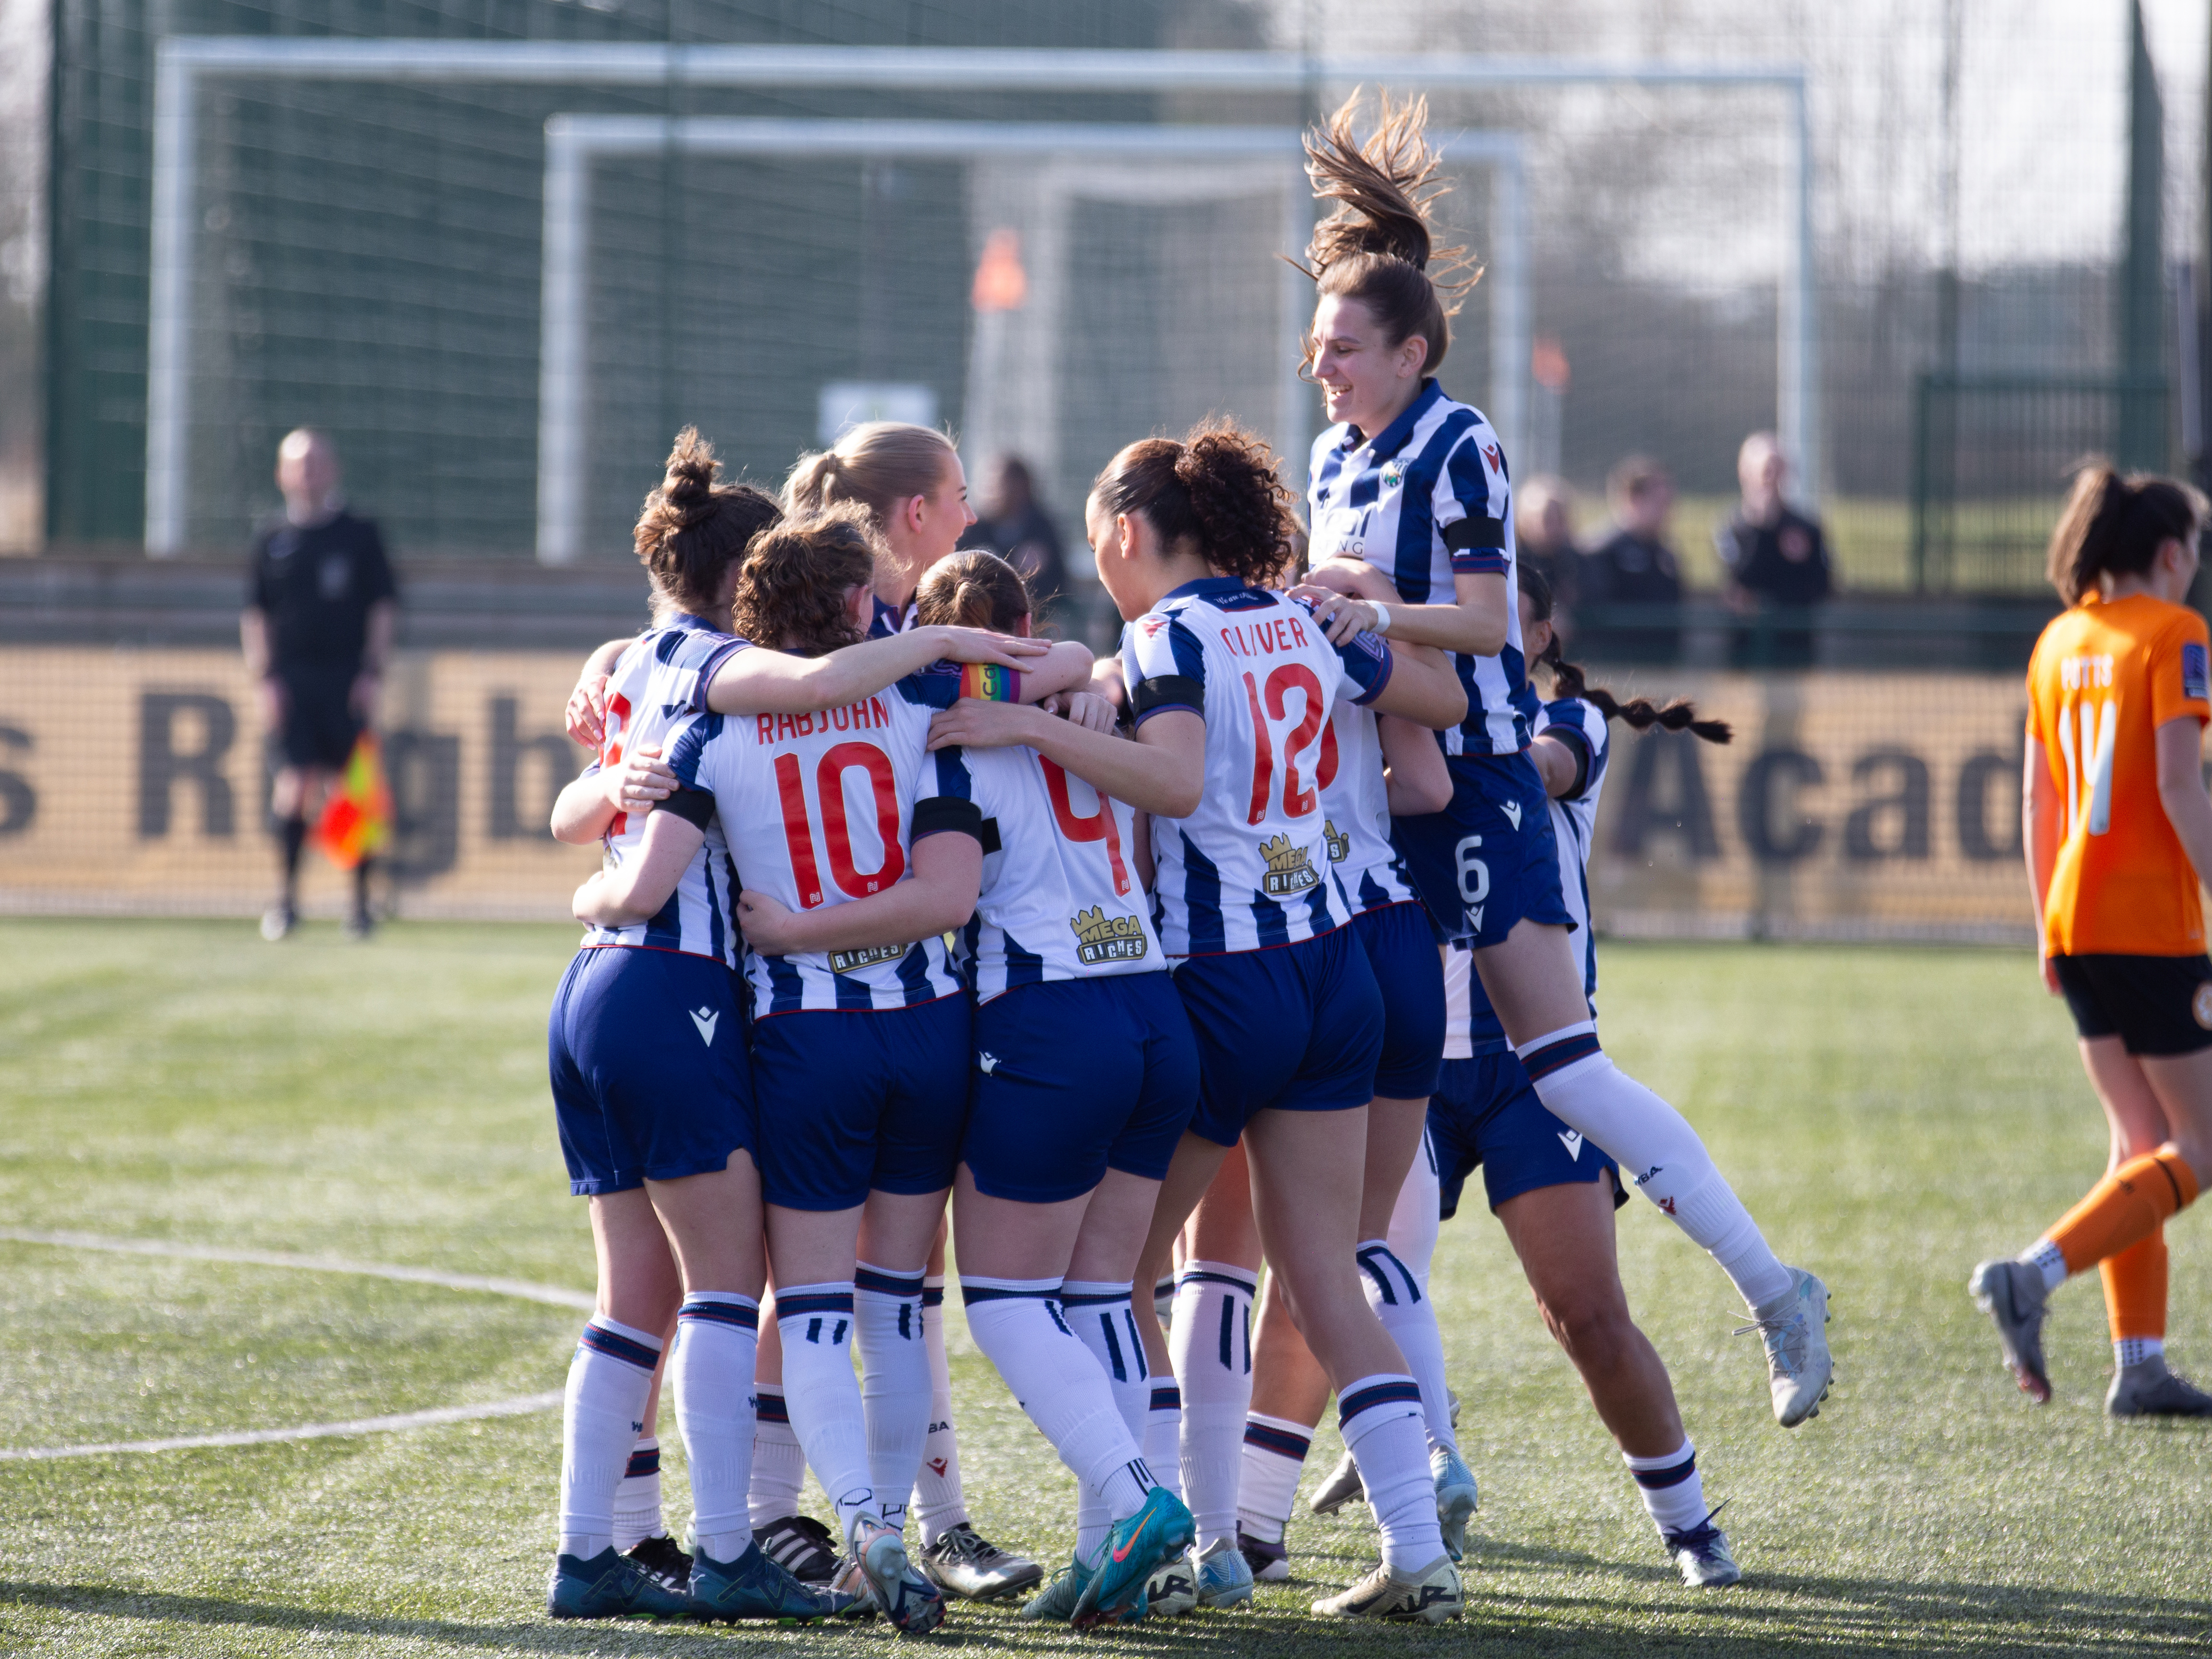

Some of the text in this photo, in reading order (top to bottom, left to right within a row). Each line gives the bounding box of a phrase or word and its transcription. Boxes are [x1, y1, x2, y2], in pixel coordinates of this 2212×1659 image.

[1221, 617, 1309, 656] OLIVER
[982, 667, 998, 696] Ca
[757, 696, 889, 745] RABJOHN
[1242, 663, 1323, 827] 12
[1615, 709, 2026, 863] Acad
[2058, 699, 2116, 838] 14
[773, 742, 906, 909] 10
[1037, 753, 1131, 898] 4
[1268, 847, 1308, 871] MEGA
[1455, 835, 1490, 904] 6
[1269, 870, 1314, 891] RICHES
[1080, 916, 1143, 943] MEGA
[834, 944, 899, 969] RICHES
[1083, 941, 1142, 961] RICHES
[928, 1421, 950, 1435] BA
